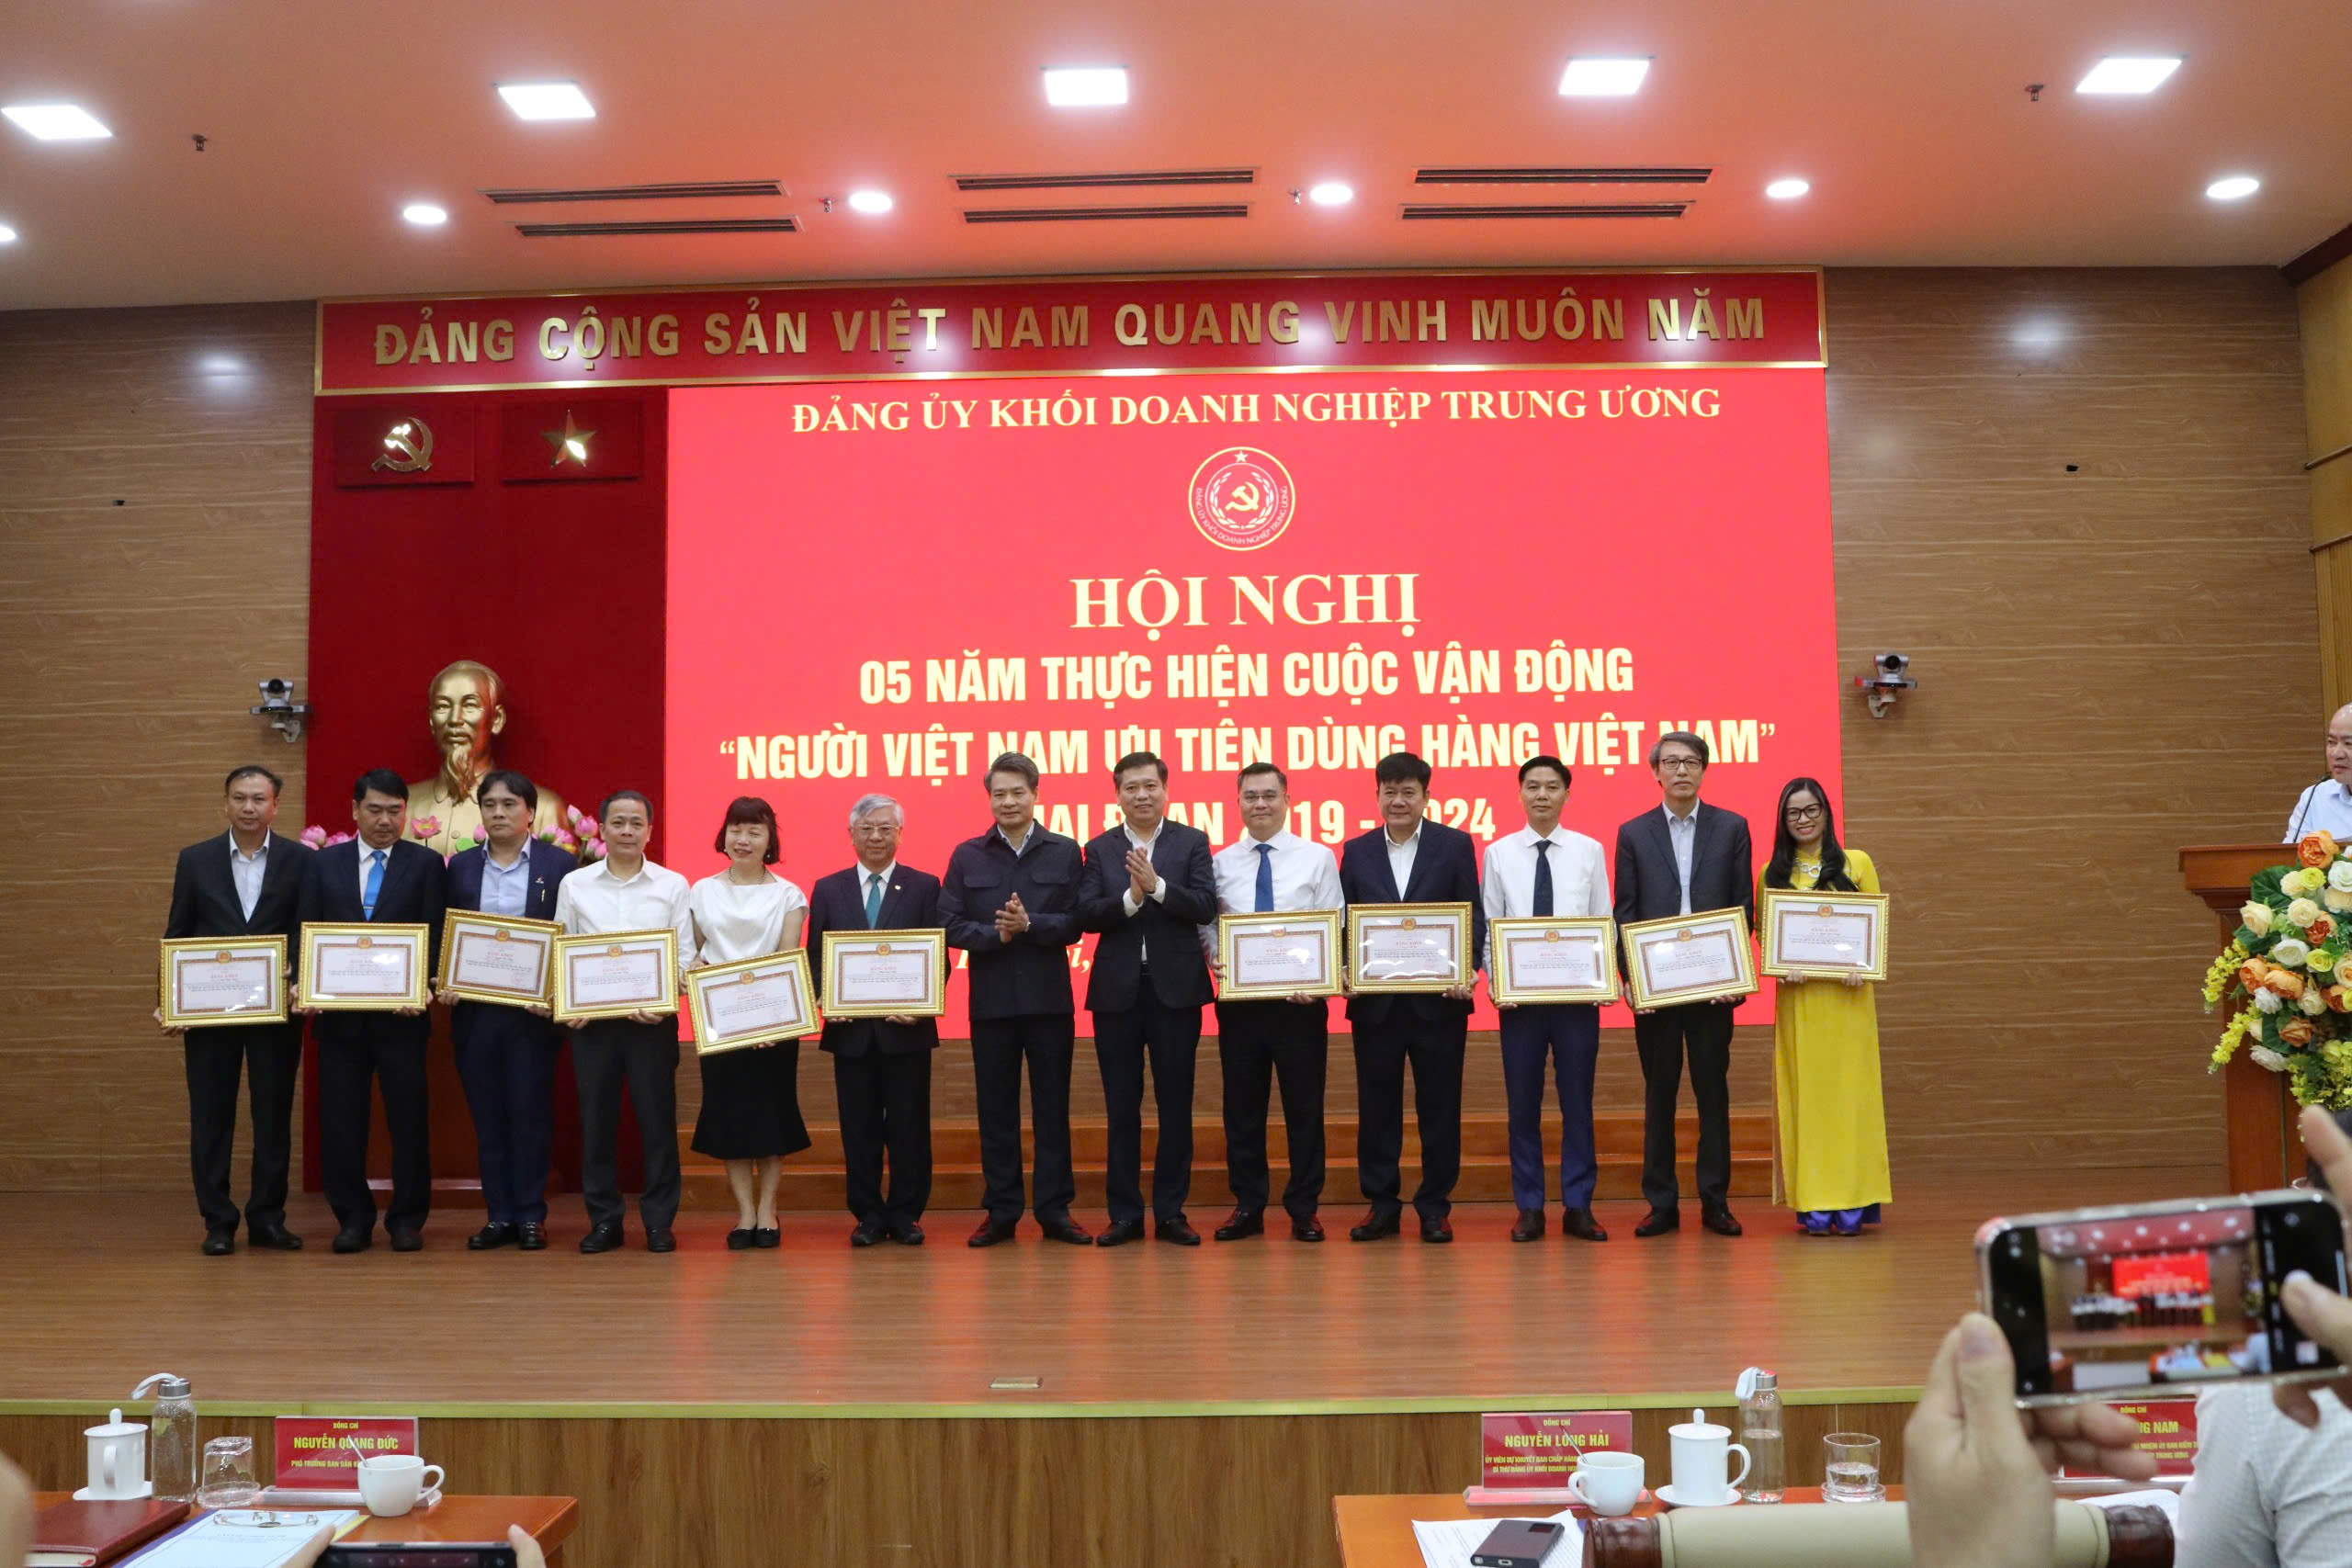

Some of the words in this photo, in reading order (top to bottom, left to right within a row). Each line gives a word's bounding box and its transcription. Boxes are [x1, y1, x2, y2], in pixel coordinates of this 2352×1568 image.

[373, 306, 514, 365] ĐẢNG
[538, 305, 680, 370] CỘNG
[704, 297, 808, 355] SẢN
[831, 299, 946, 363] VIỆT
[971, 306, 1089, 349] NAM
[1114, 300, 1300, 346] QUANG
[1323, 299, 1447, 344] VINH
[1471, 287, 1624, 342] MUÔN
[1647, 288, 1765, 342] NĂM
[792, 394, 910, 432] ĐẢNG
[921, 391, 978, 428] ỦY
[989, 389, 1098, 427] KHỐI
[1110, 393, 1261, 425] DOANH
[1272, 387, 1431, 429] NGHIỆP
[1441, 389, 1588, 420] TRUNG
[1599, 384, 1722, 418] ƯƠNG
[1069, 568, 1209, 642] HỘI
[1227, 573, 1421, 638] NGHỊ
[860, 660, 912, 705] 05
[925, 649, 1026, 703] NĂM
[1040, 650, 1152, 709] THỰC
[1166, 644, 1269, 707] HIỆN
[1283, 642, 1399, 705] CUỘC
[1412, 640, 1501, 704] VẬN
[1513, 639, 1634, 703] ĐỘNG
[719, 722, 868, 780] “NGƯỜI
[882, 723, 974, 787] VIỆT
[1174, 717, 1276, 773] TIÊN
[1286, 716, 1406, 771] DÙNG
[1420, 713, 1541, 769] HÀNG
[1553, 712, 1645, 776] VIỆT
[1359, 819, 1376, 829] -
[293, 1434, 336, 1449] NGUYỄN
[377, 1435, 399, 1450] ĐỨC
[1504, 1431, 1552, 1448] NGUYỄN
[1589, 1429, 1610, 1447] HẢI
[2153, 1420, 2179, 1434] NAM
